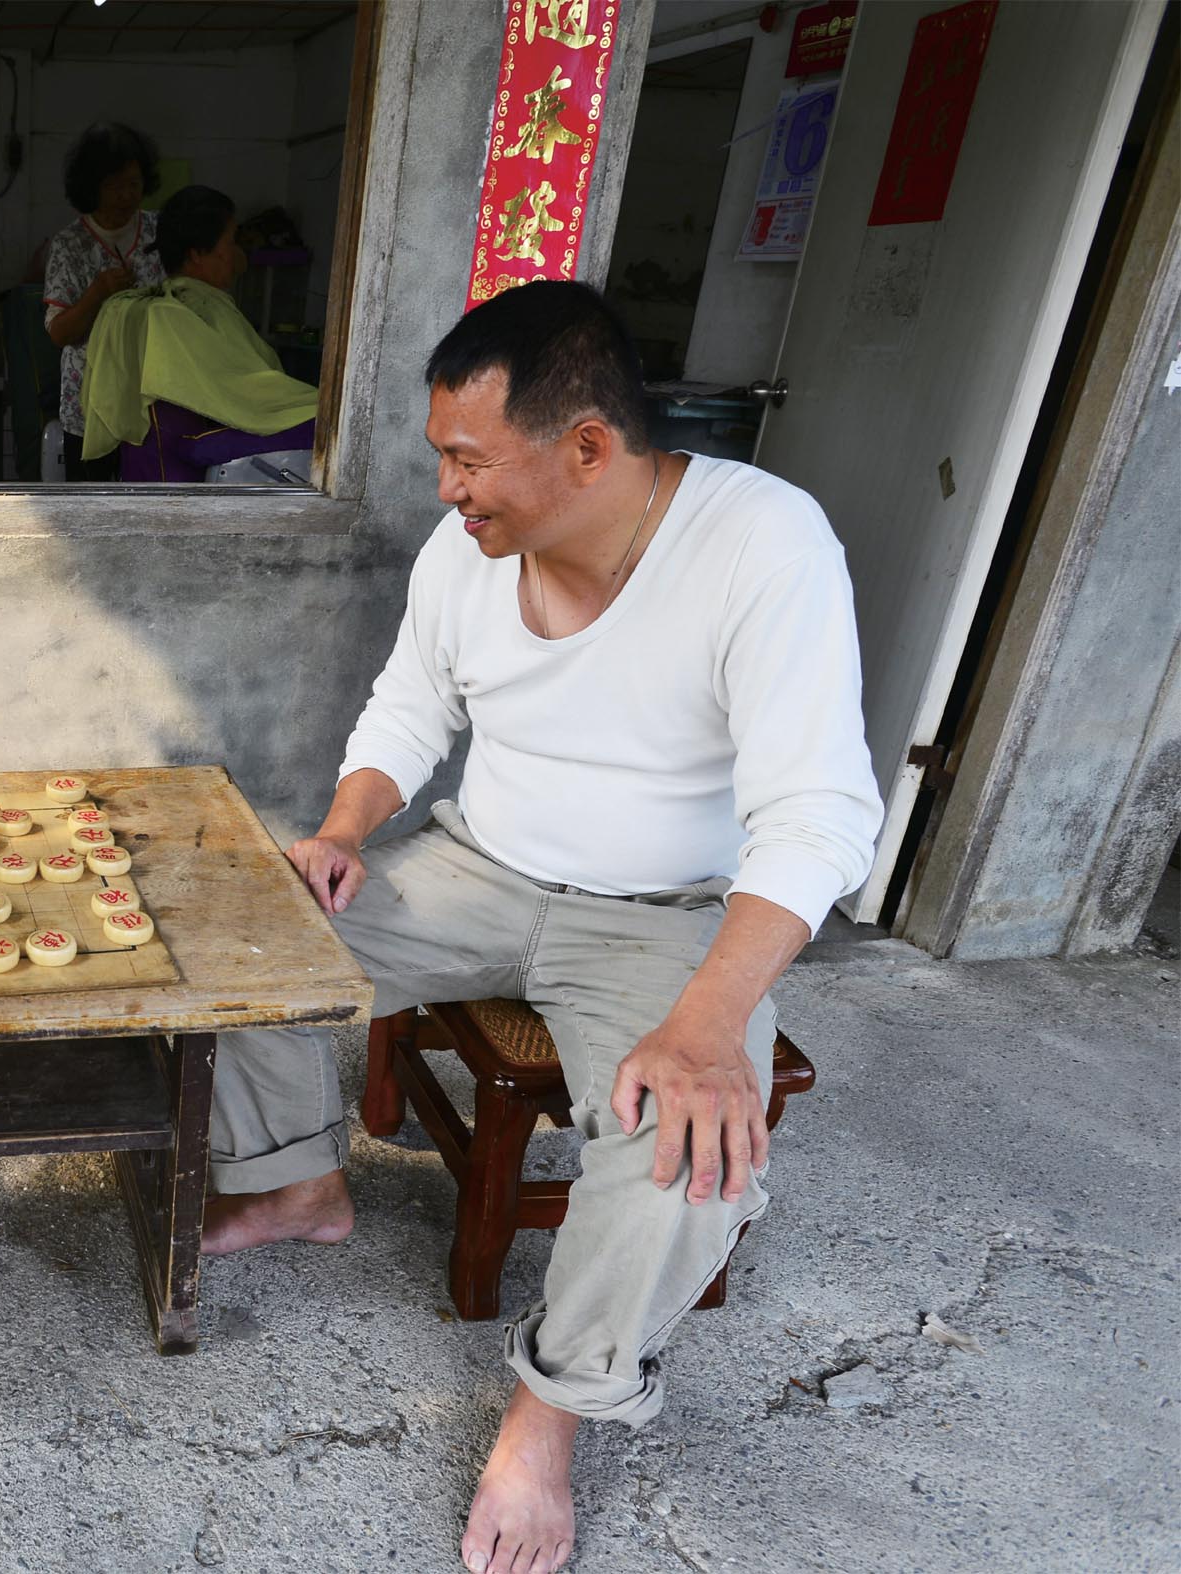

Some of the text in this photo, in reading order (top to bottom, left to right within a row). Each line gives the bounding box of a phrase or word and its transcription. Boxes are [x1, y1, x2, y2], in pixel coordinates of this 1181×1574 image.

[784, 92, 834, 175] 6
[80, 828, 105, 842] 仕
[49, 854, 76, 868] 仕
